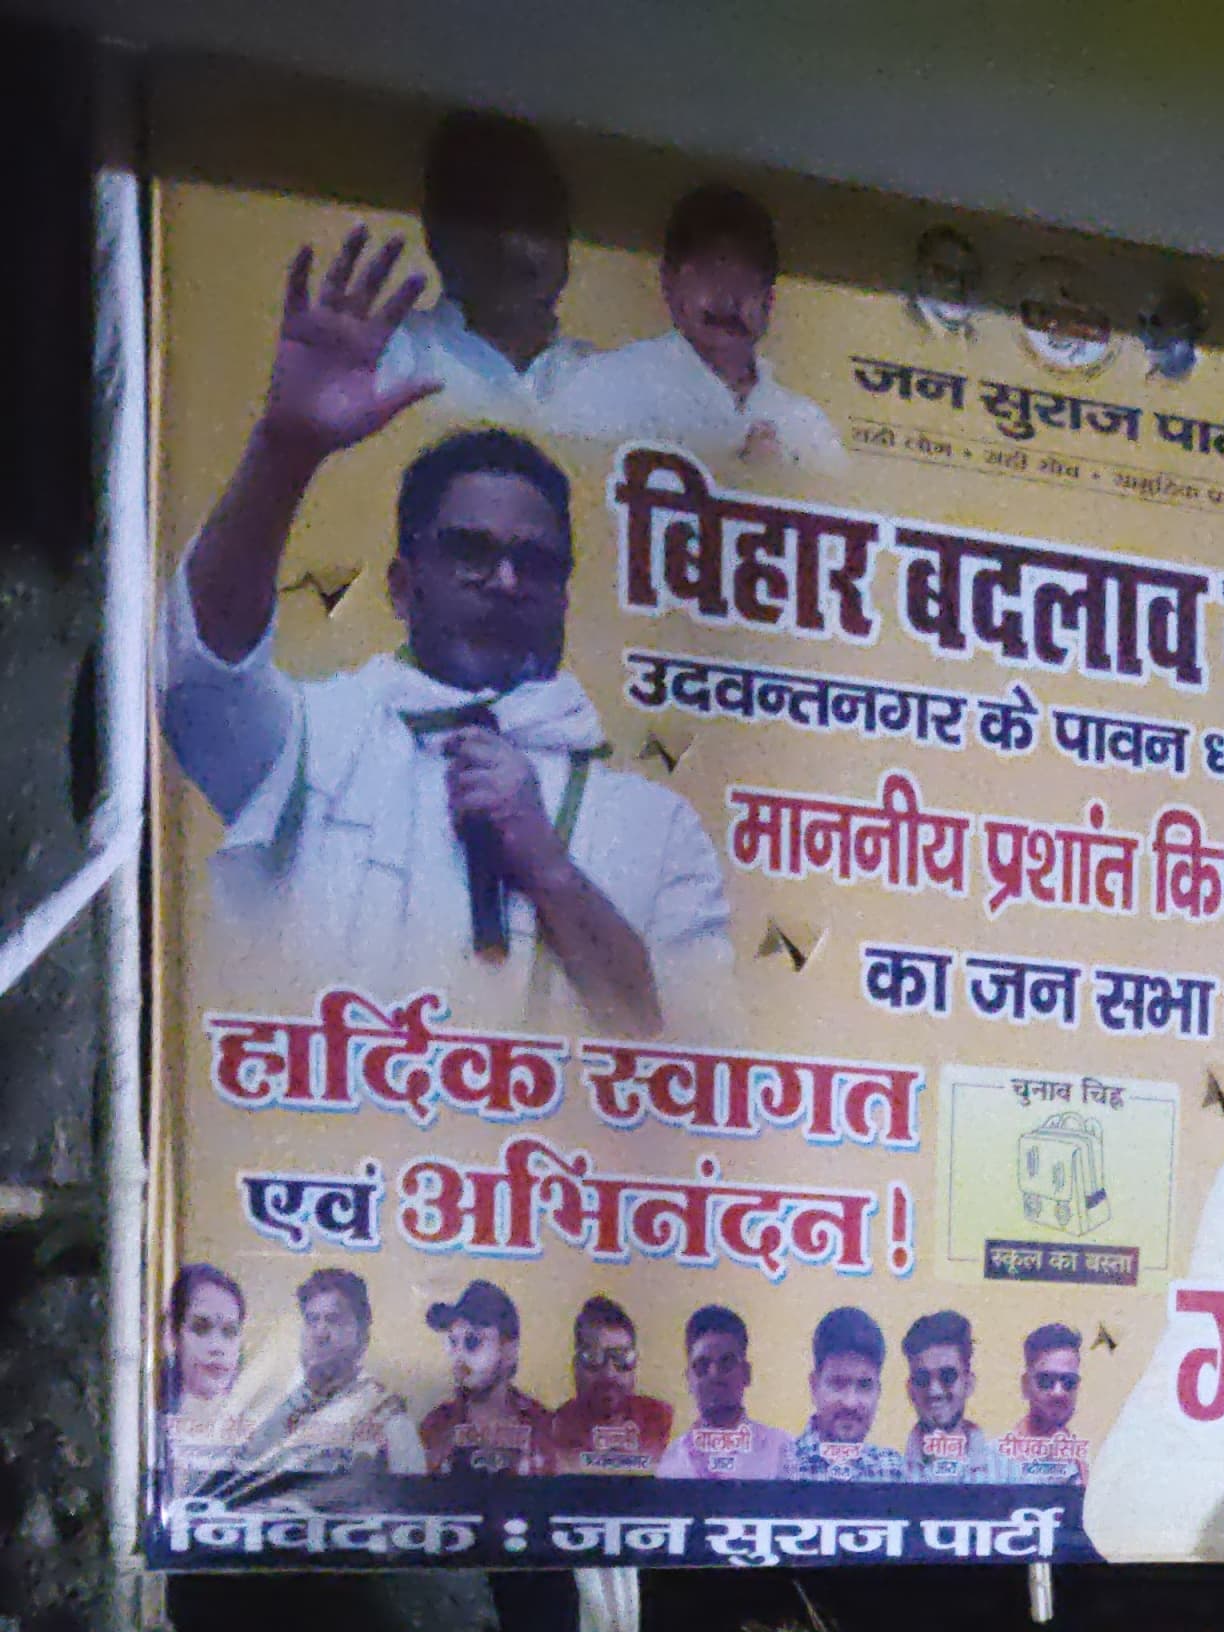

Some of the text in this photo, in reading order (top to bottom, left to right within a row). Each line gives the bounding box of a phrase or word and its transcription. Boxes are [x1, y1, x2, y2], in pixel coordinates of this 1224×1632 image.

[849, 355, 967, 410] जन
[979, 379, 1143, 441] सुराज
[614, 447, 879, 638] बिहार
[894, 526, 1209, 685] बदलाव
[626, 653, 968, 746] उदवन्तनगर
[977, 683, 1038, 750] के
[1052, 709, 1190, 774] पावन
[730, 774, 969, 892] माननीय
[984, 804, 1138, 914] प्रशांत
[864, 946, 951, 1012] का
[966, 957, 1081, 1024] जन
[1095, 968, 1214, 1036] सभा
[208, 990, 920, 1142] हार्दिक स्वागत
[1010, 1077, 1073, 1107] चुनाव
[242, 1136, 911, 1273] एवं अभिनंदन!
[549, 1514, 694, 1556] जन
[704, 1515, 910, 1567] सुराज
[920, 1507, 1066, 1558] पार्टी
